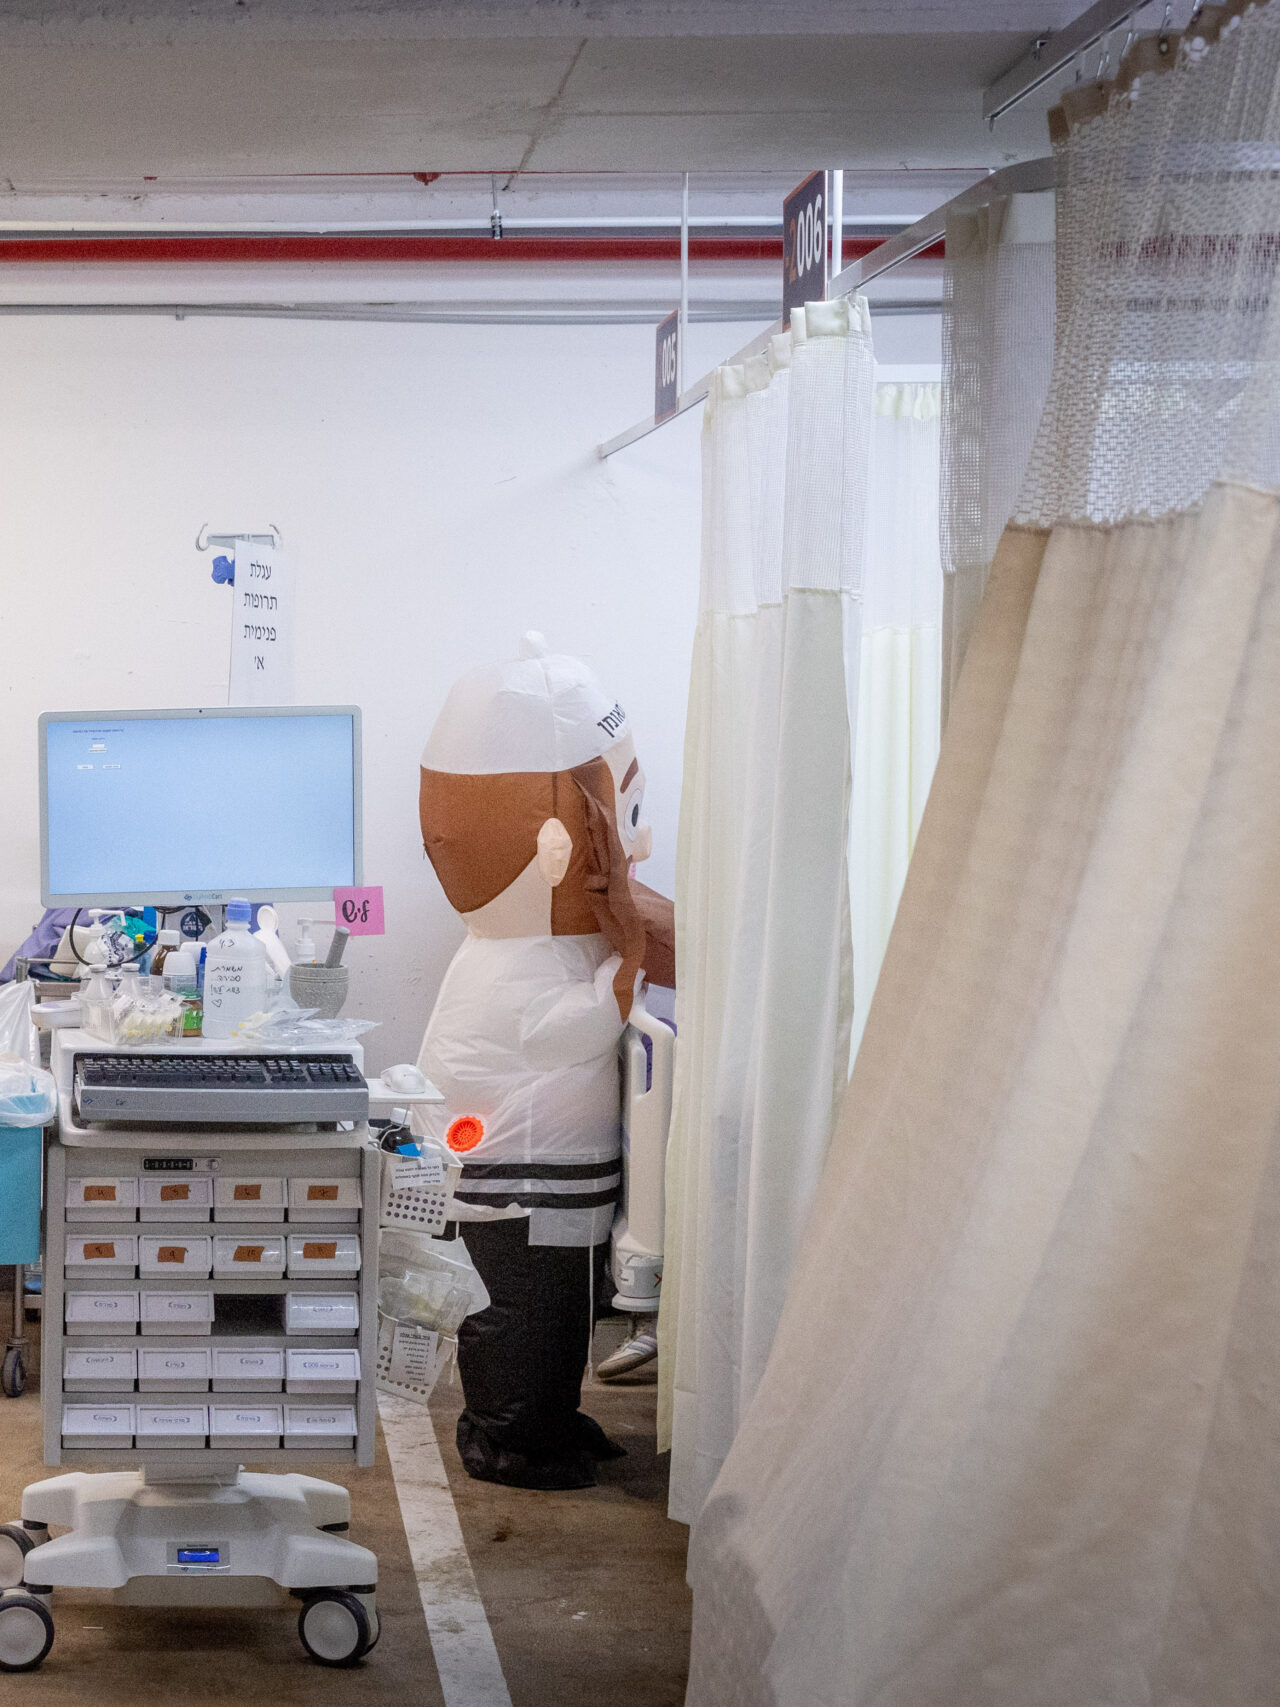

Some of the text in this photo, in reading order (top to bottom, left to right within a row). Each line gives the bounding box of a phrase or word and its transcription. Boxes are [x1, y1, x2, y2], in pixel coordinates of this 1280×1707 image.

[784, 193, 823, 285] -2006
[249, 559, 272, 581] עגלת
[243, 591, 278, 611] תרופות
[243, 623, 277, 642] פנימית
